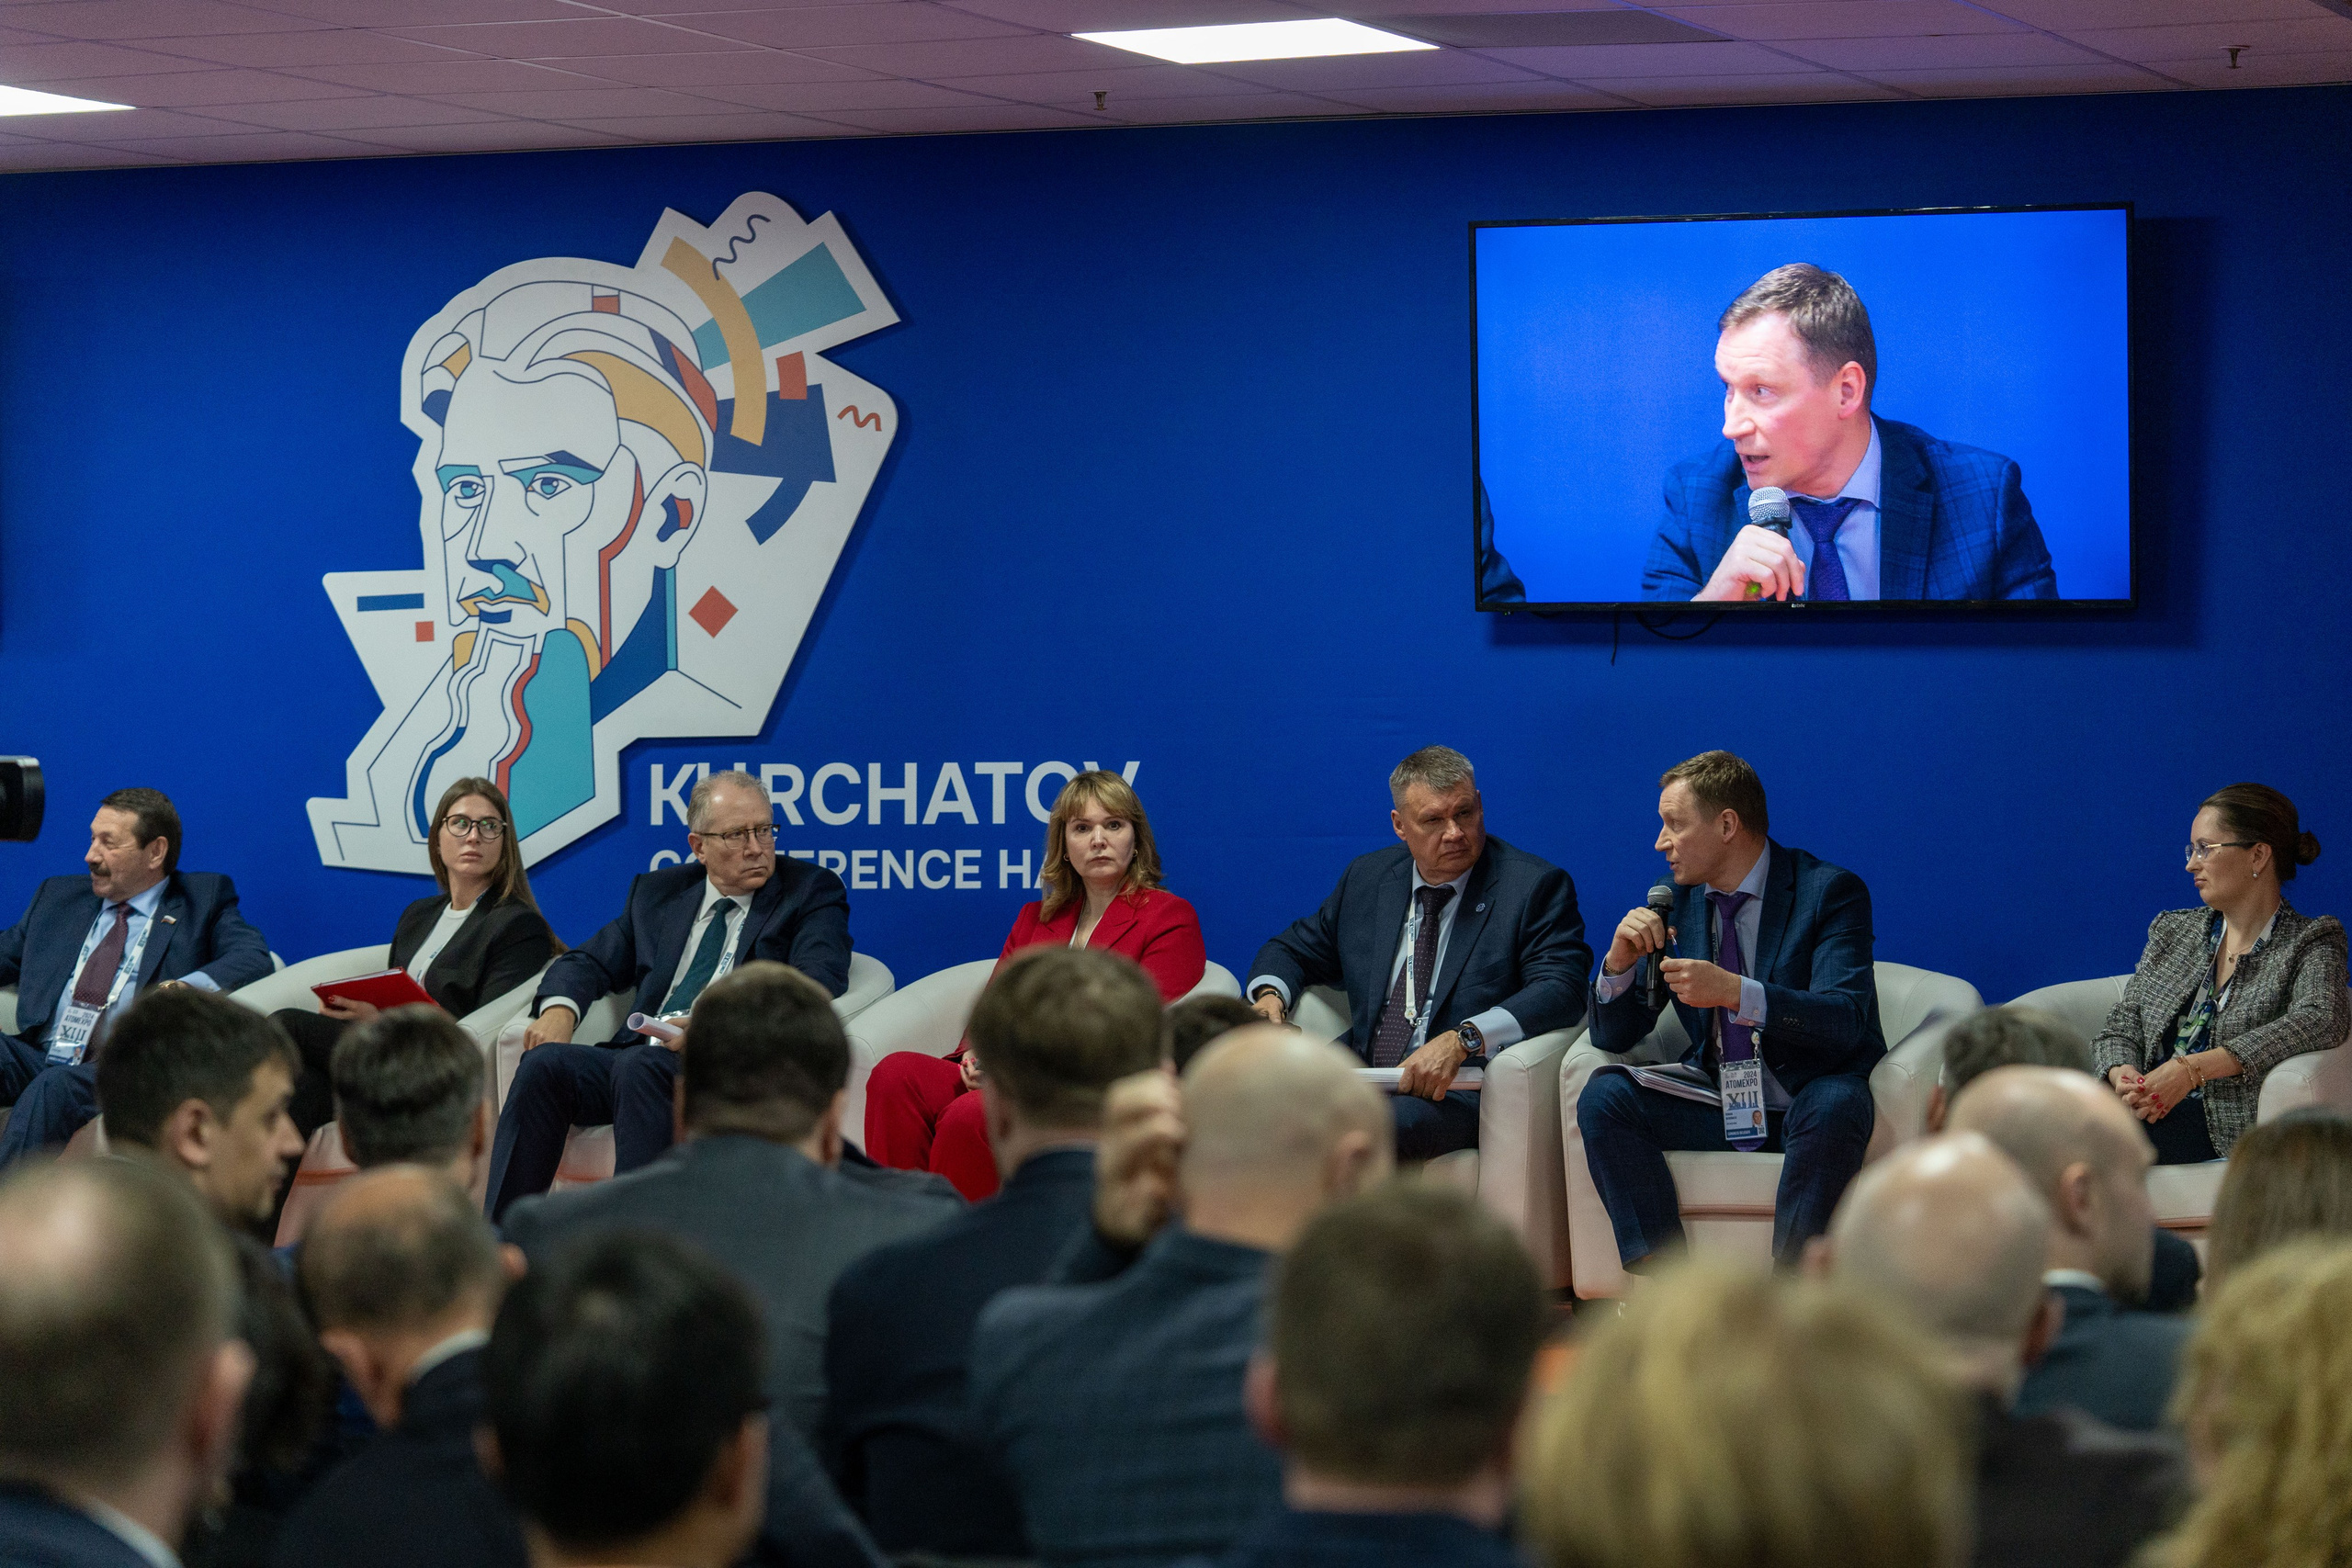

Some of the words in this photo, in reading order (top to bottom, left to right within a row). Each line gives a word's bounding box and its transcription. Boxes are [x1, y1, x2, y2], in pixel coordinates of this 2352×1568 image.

[650, 761, 1140, 826] KRCHATO
[1744, 1070, 1757, 1078] 2024
[1725, 1078, 1758, 1089] ATOMEXPO
